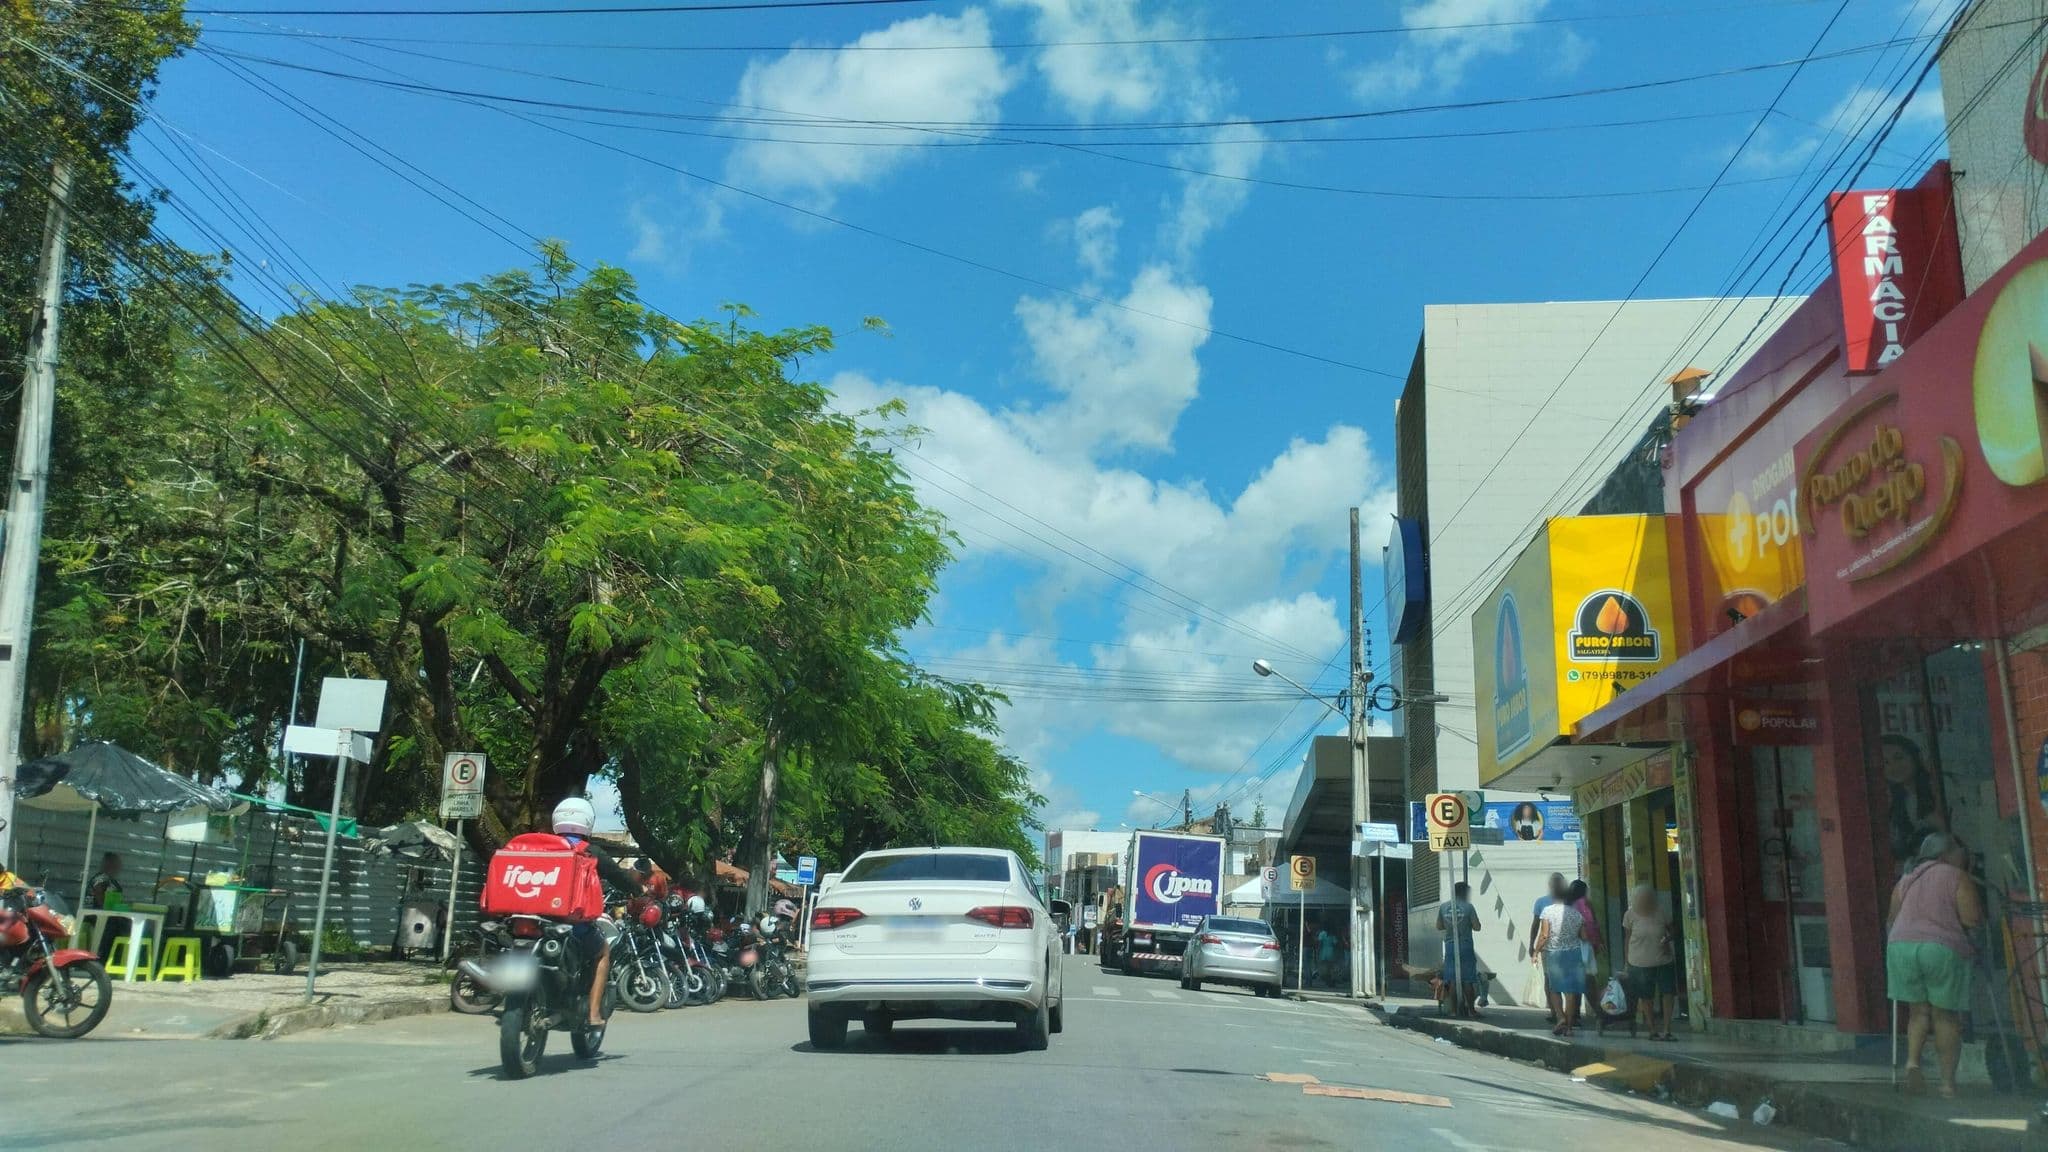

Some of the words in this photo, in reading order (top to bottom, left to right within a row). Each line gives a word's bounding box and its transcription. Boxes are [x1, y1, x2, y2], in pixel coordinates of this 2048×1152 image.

[1862, 195, 1906, 363] FARMÁCIA
[1576, 636, 1609, 648] PURO
[1612, 636, 1652, 648] SABOR
[1761, 717, 1817, 729] POPULAR
[460, 764, 469, 780] E
[1441, 802, 1453, 820] E
[1435, 836, 1464, 847] TAXI
[1300, 861, 1308, 873] E
[503, 865, 561, 888] ifood
[1268, 870, 1275, 880] E
[1163, 871, 1212, 896] jpm
